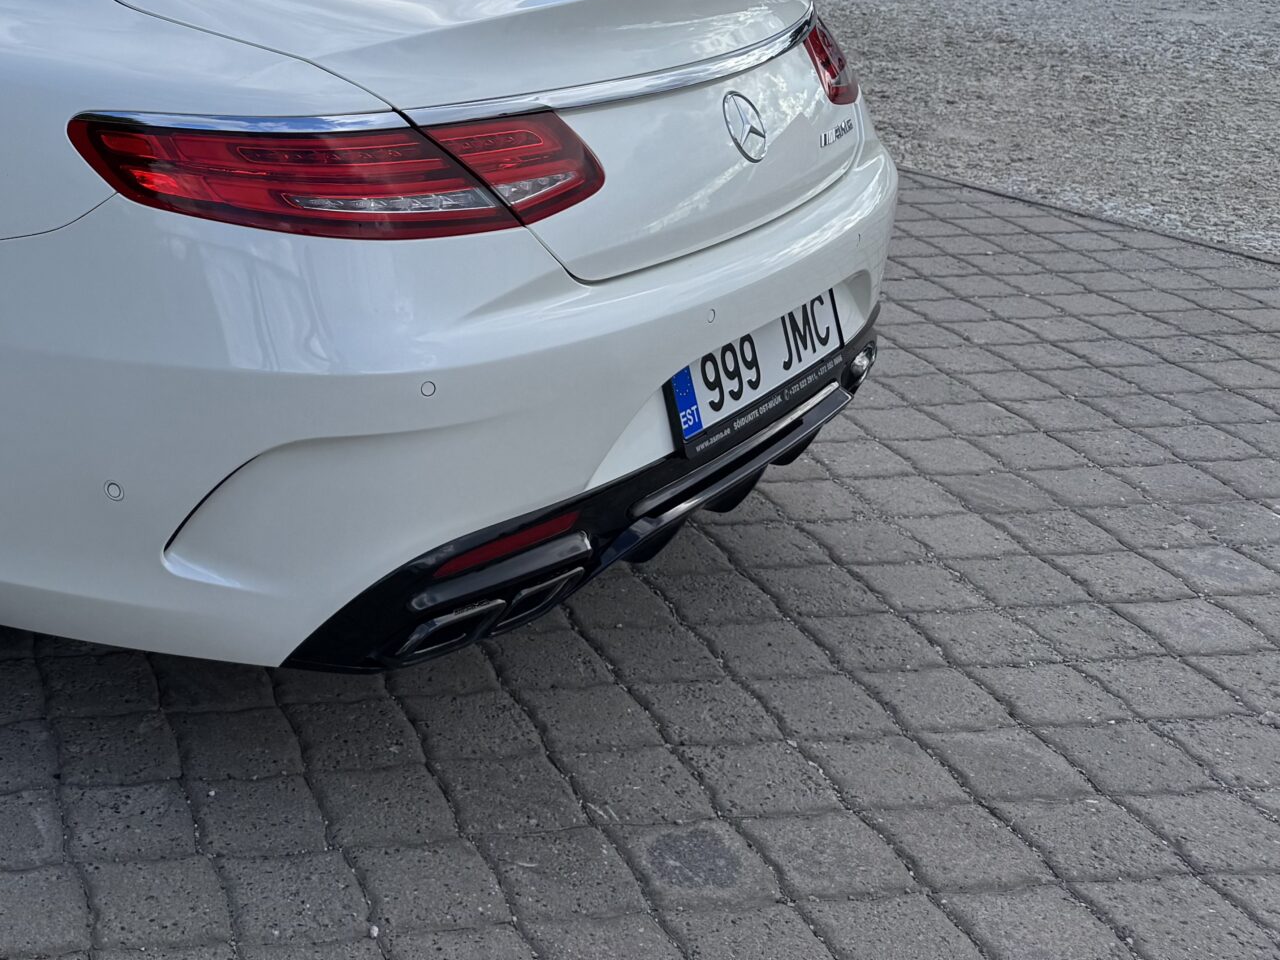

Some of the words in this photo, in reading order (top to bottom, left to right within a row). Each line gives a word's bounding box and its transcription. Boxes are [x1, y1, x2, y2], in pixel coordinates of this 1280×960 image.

[700, 333, 762, 412] 999
[780, 294, 830, 371] JMC
[679, 405, 700, 430] EST
